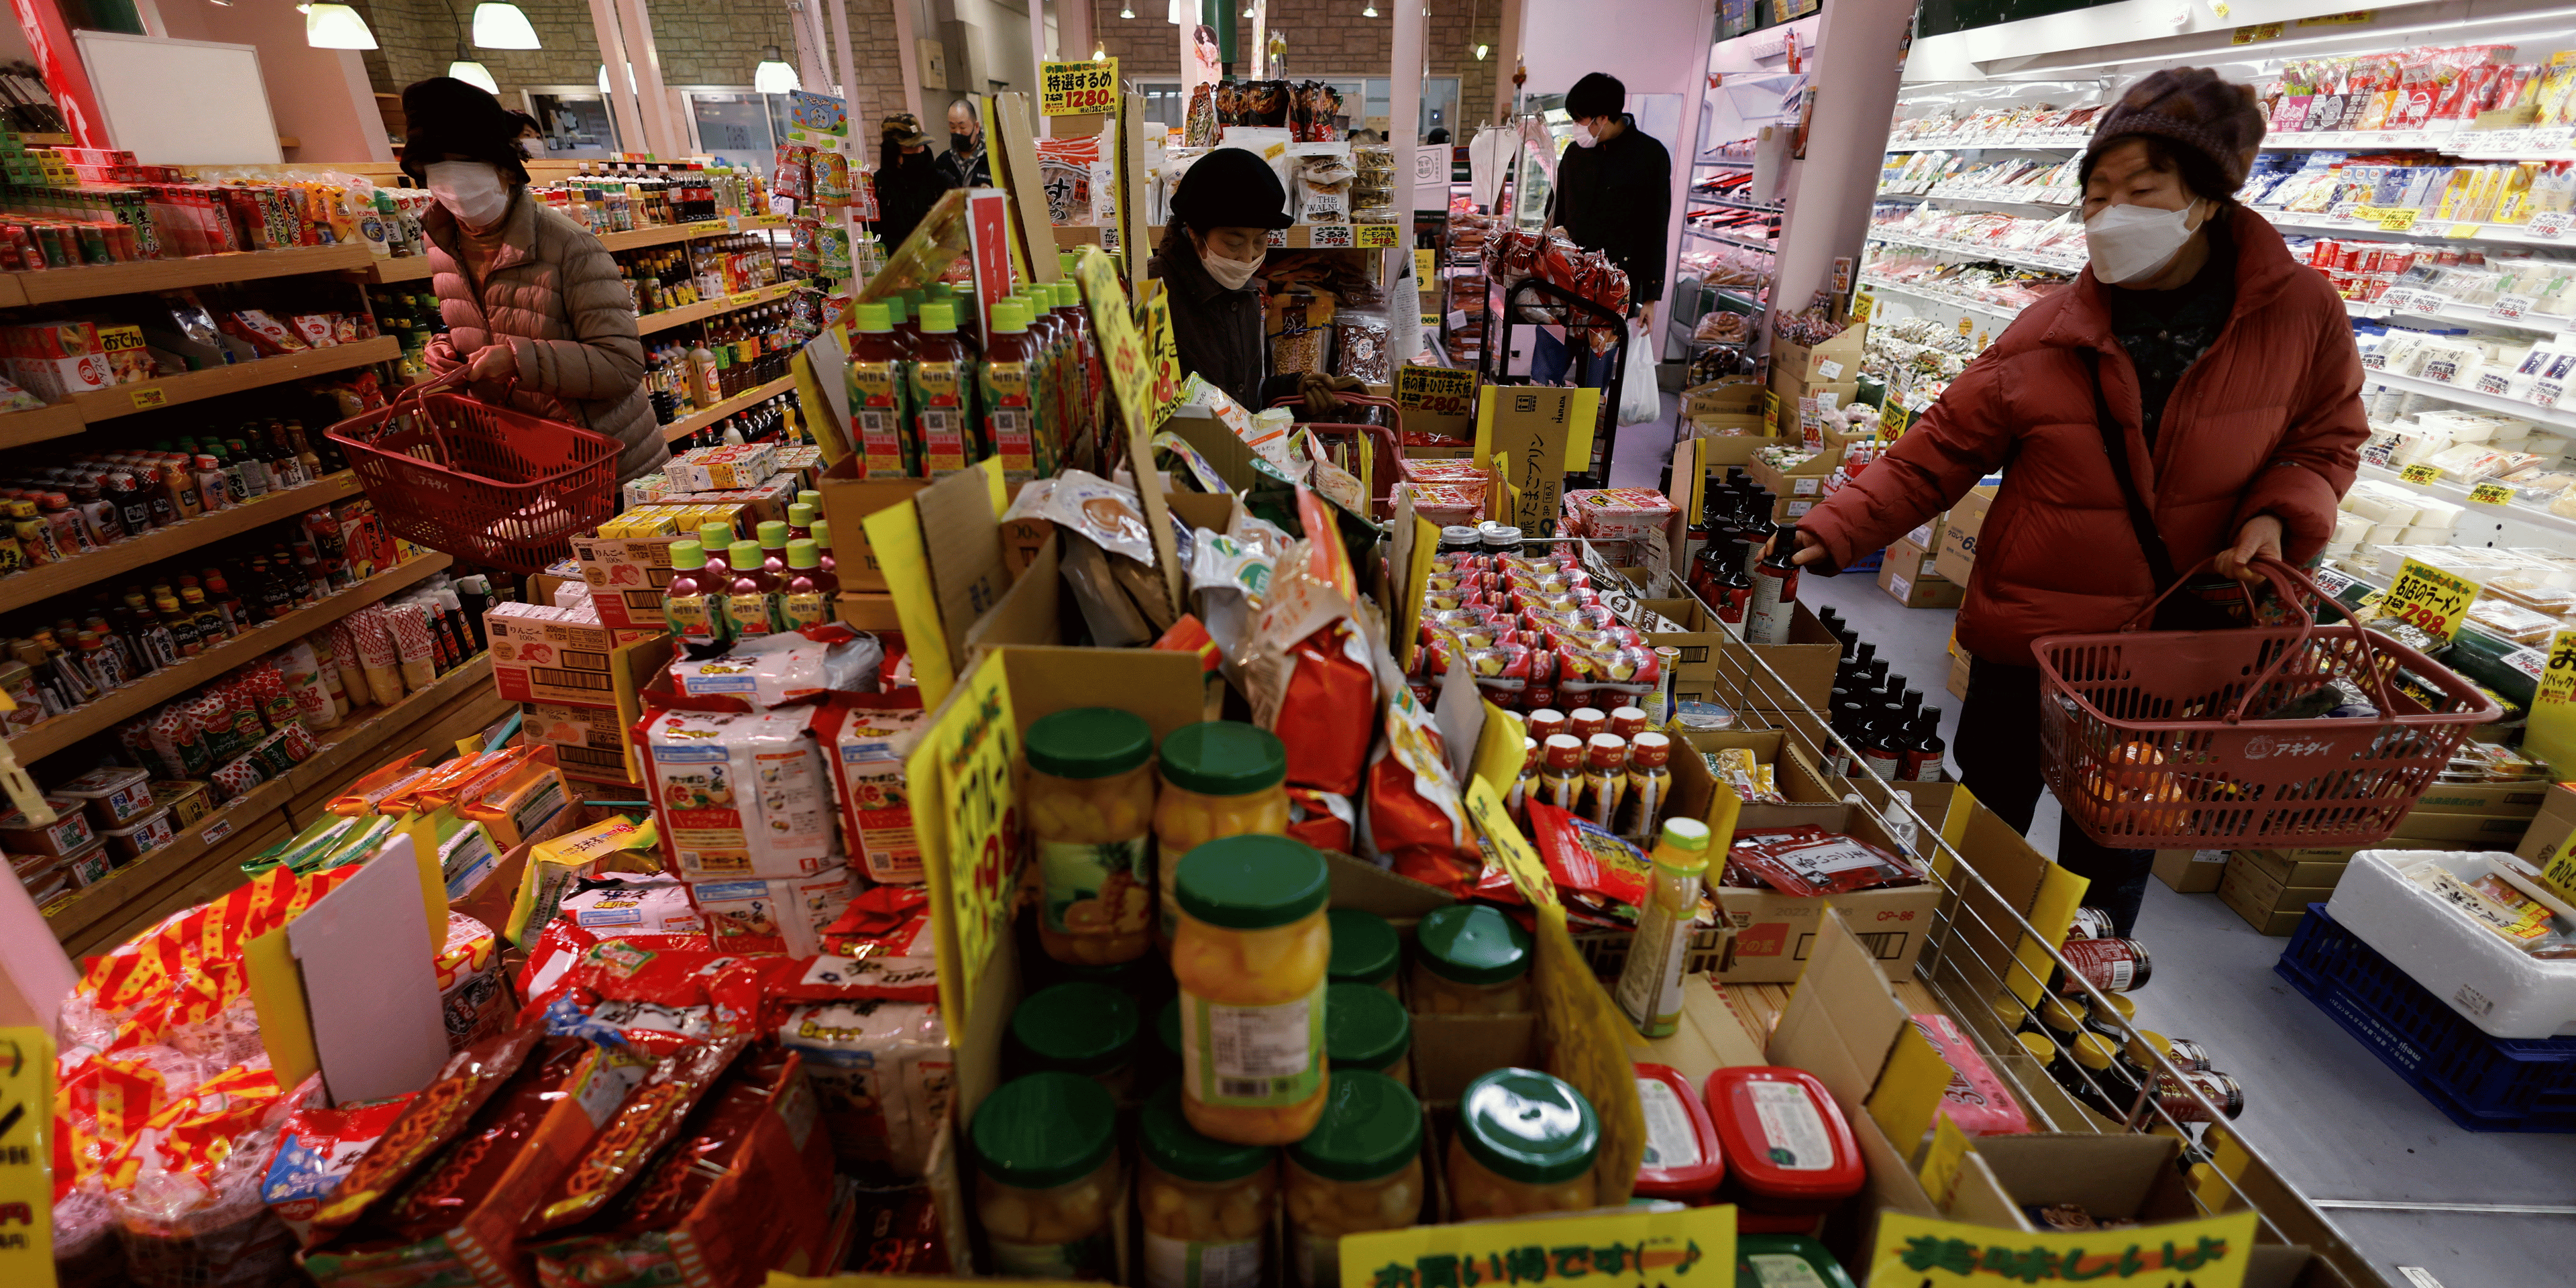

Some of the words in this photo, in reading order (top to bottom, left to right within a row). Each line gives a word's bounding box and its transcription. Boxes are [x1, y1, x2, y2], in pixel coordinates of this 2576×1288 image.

[1047, 71, 1112, 92] 特選するめ
[135, 207, 160, 254] 生わさび
[101, 331, 144, 351] おでん
[1552, 396, 1566, 423] HARADA
[1947, 530, 1964, 541] クロレラ
[2396, 574, 2461, 616] 名店のラーメン
[546, 625, 567, 633] 200ml
[2273, 742, 2334, 757] アキダイ
[1876, 911, 1915, 921] CP-86
